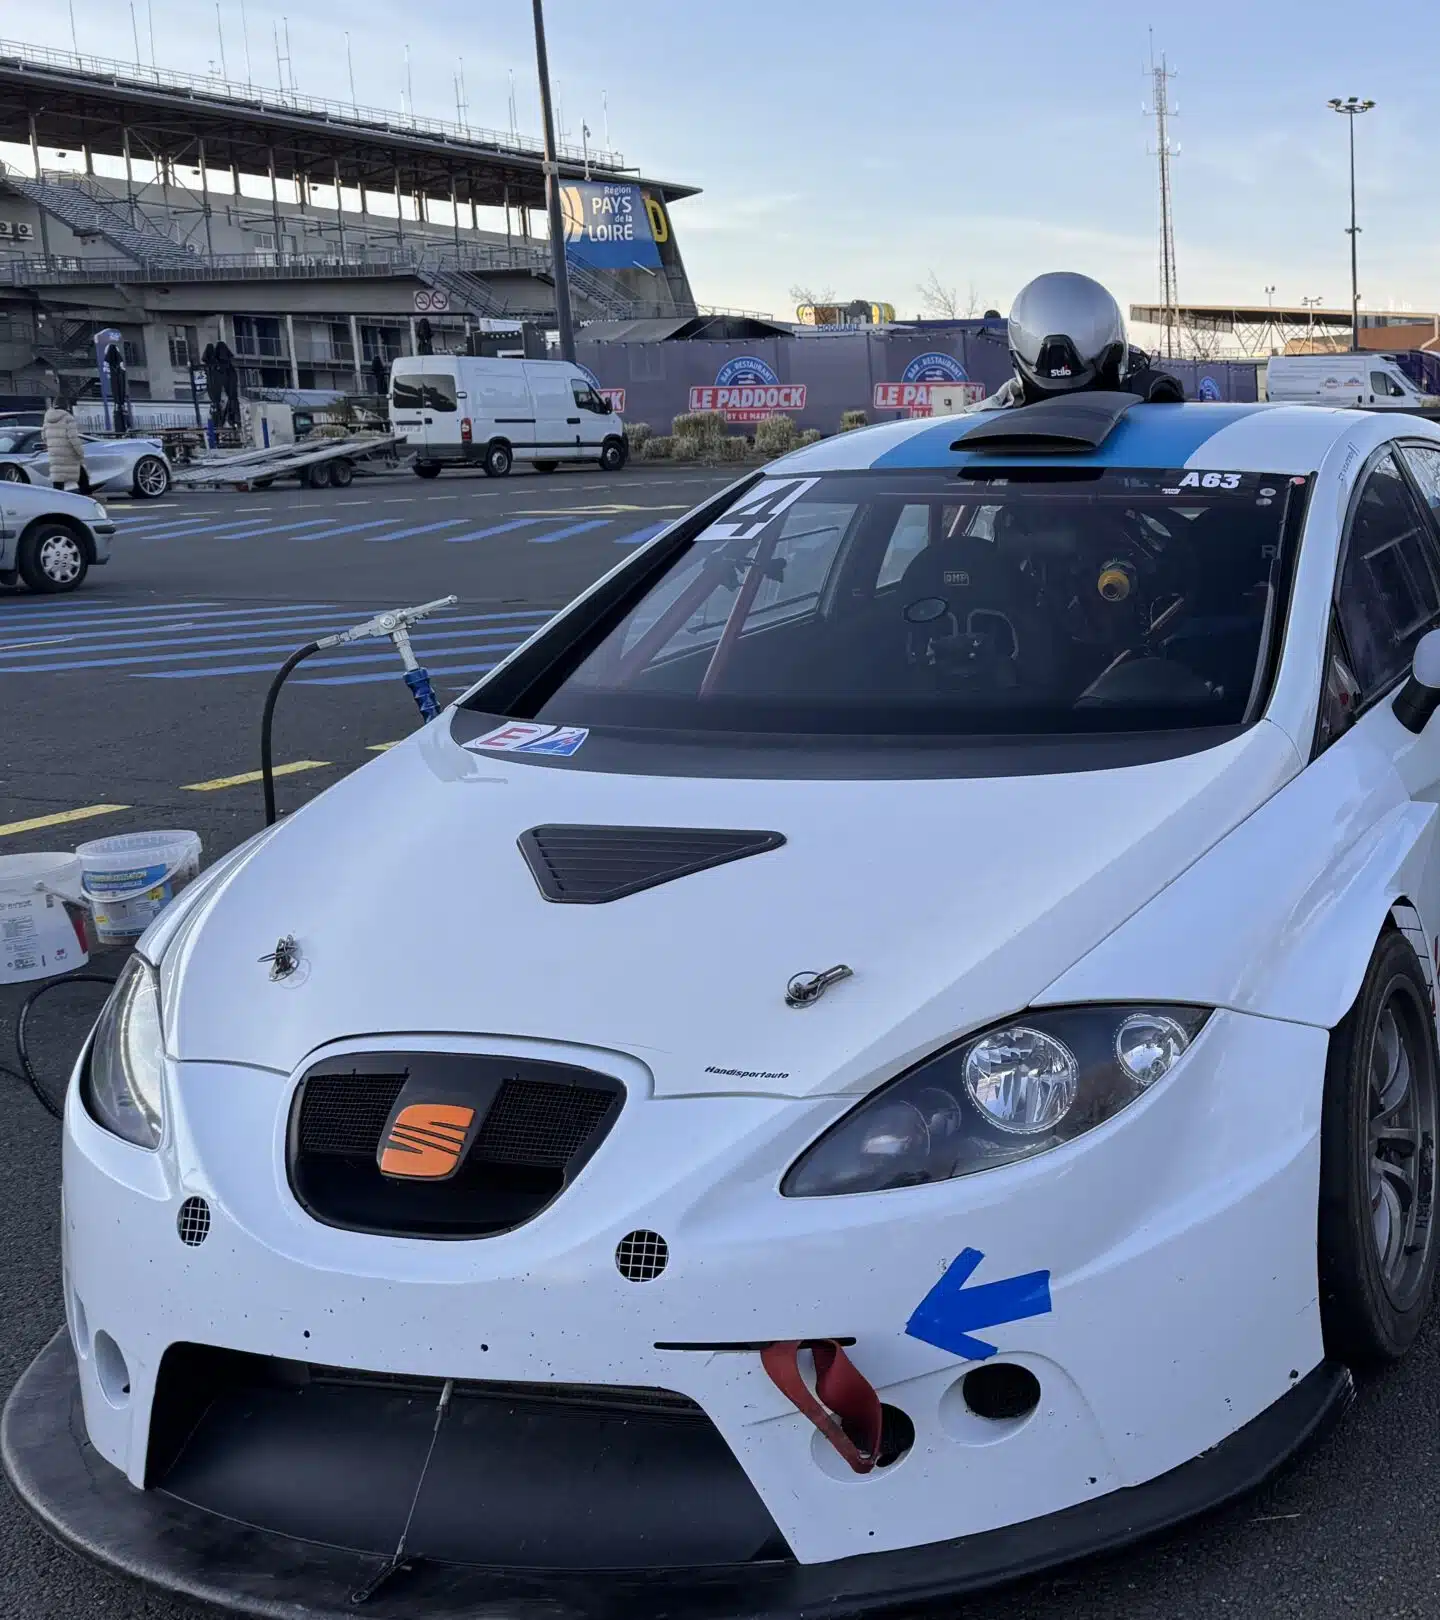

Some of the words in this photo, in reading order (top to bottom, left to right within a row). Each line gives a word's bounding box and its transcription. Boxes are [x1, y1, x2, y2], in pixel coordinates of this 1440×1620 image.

[604, 186, 631, 196] Région
[592, 197, 632, 214] PAYS
[615, 215, 624, 223] de
[625, 215, 633, 223] la
[588, 224, 634, 242] LOIRE
[691, 389, 712, 408] LE
[717, 387, 804, 408] PADDOCK
[877, 386, 900, 406] LE
[903, 385, 983, 405] PACK
[1179, 471, 1242, 489] A63
[713, 479, 808, 537] 4
[480, 727, 539, 747] E
[704, 1065, 790, 1079] Handisportauto
